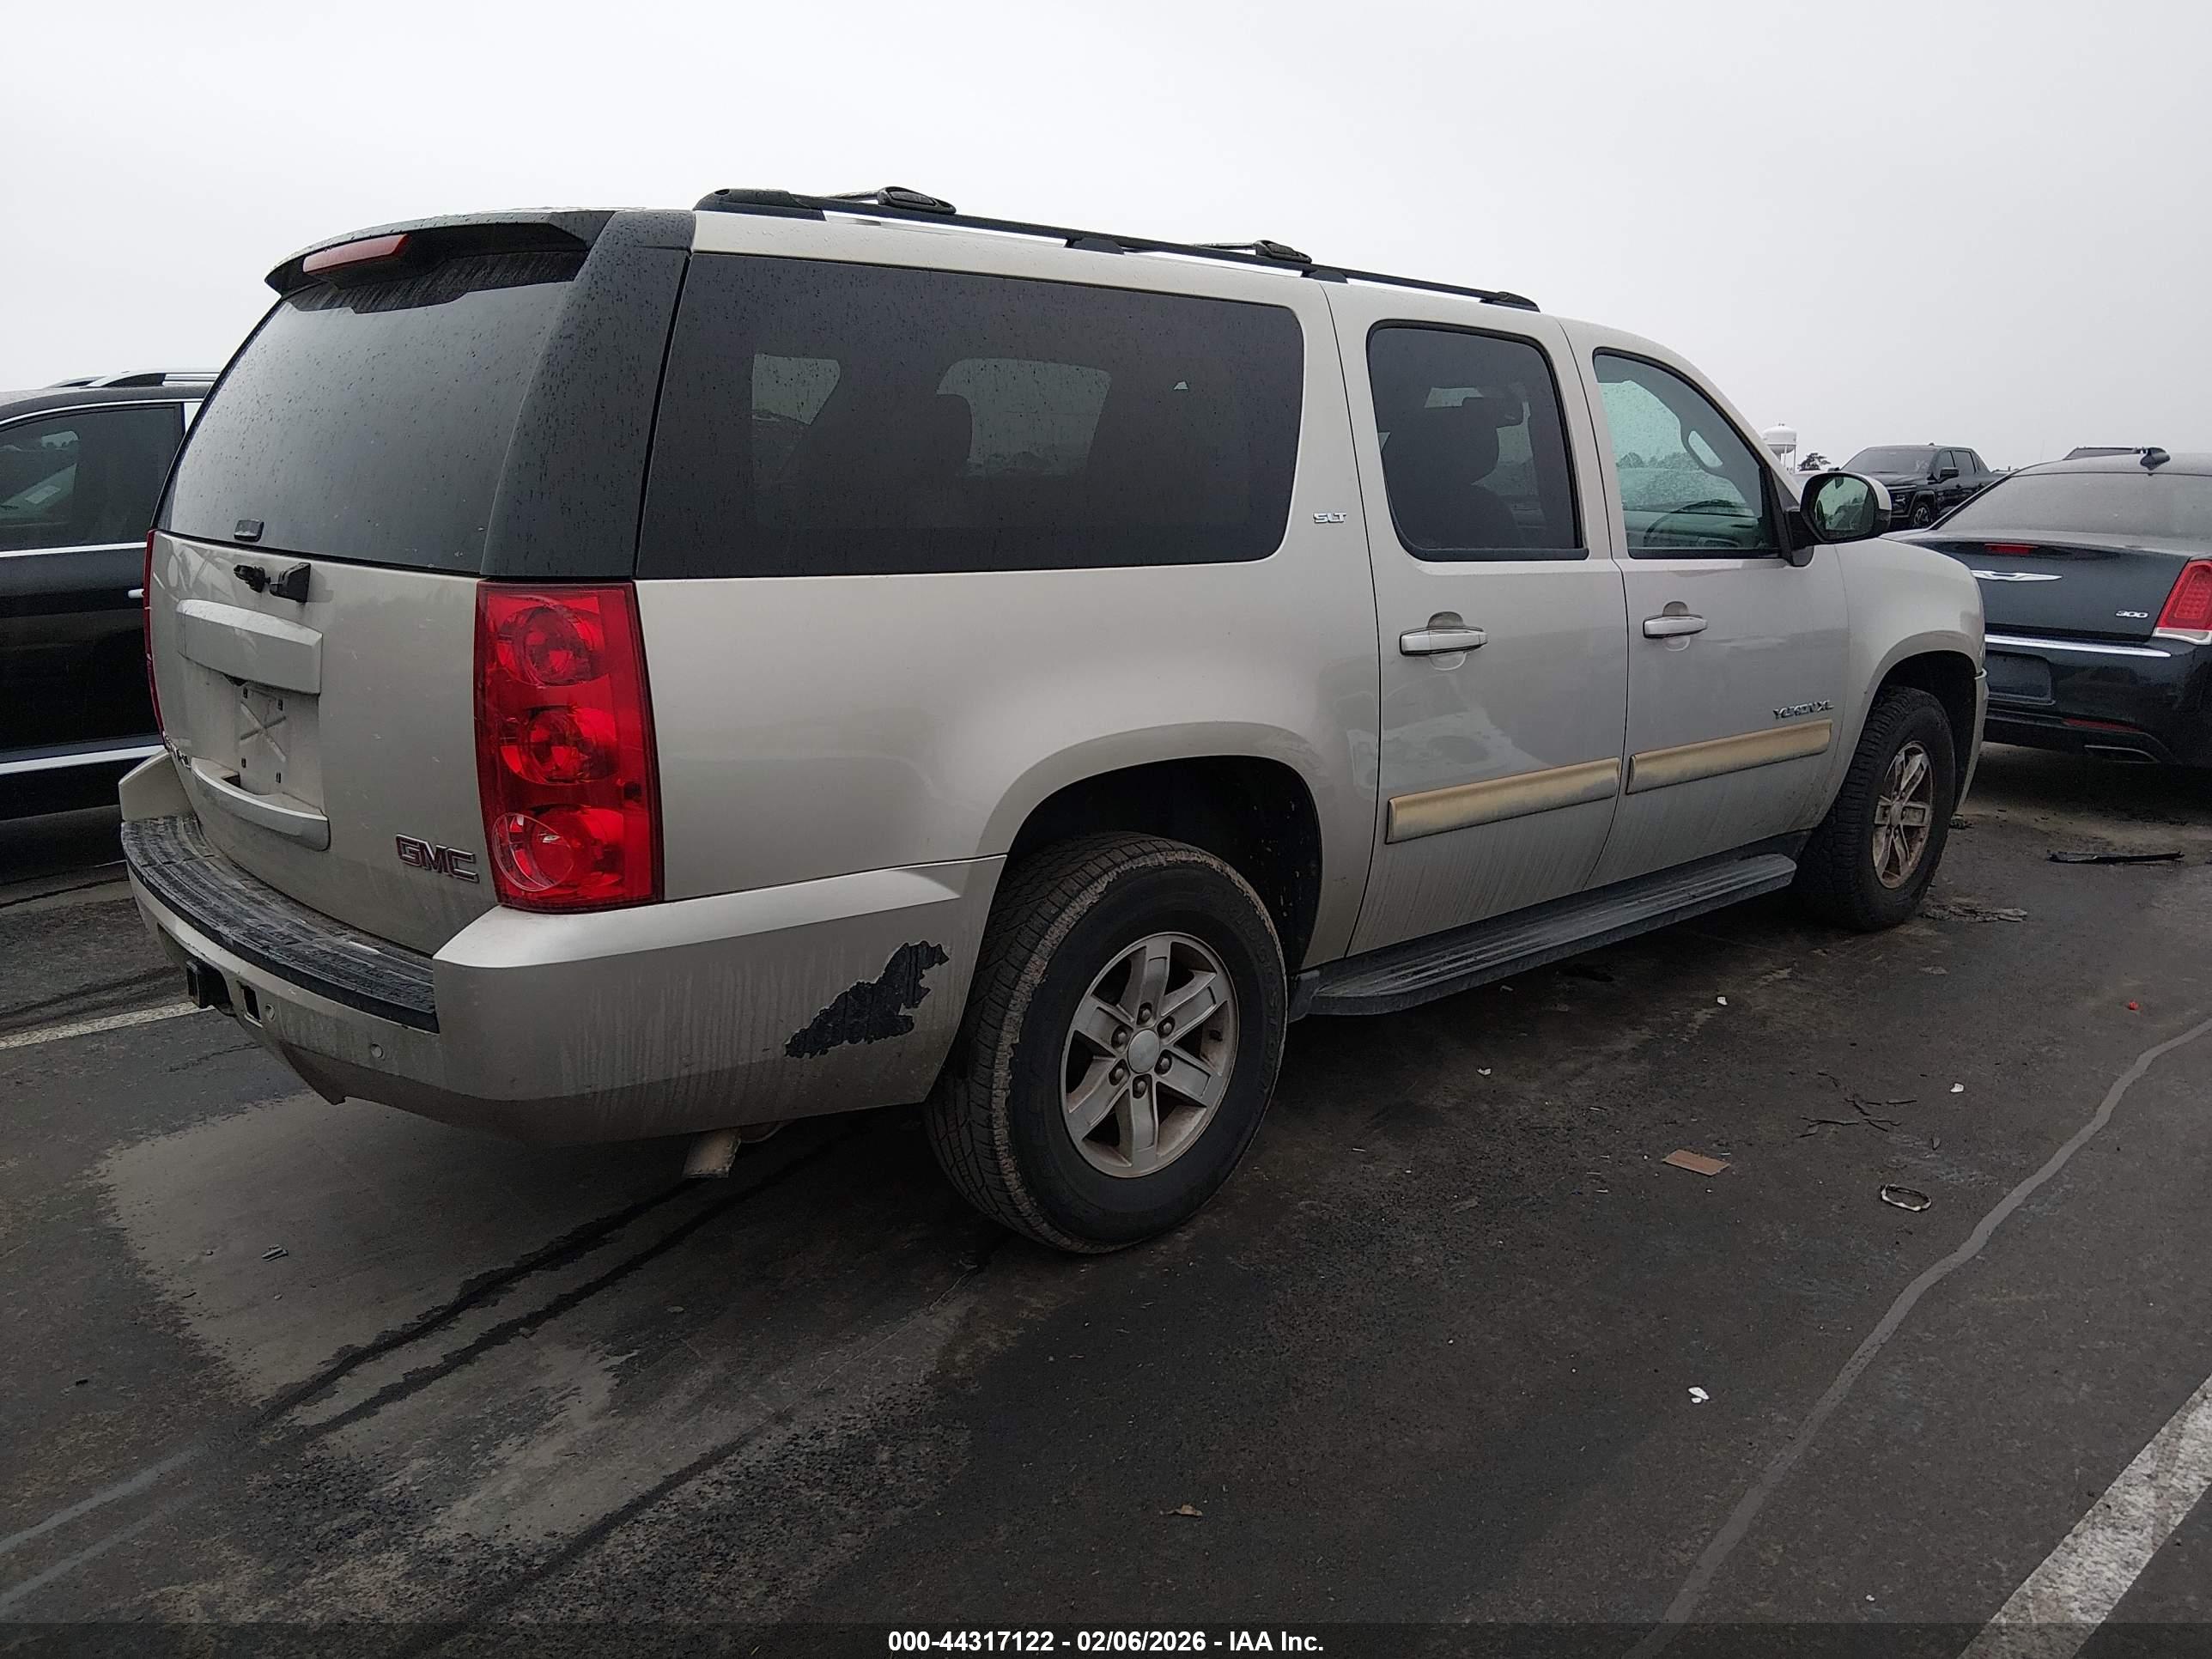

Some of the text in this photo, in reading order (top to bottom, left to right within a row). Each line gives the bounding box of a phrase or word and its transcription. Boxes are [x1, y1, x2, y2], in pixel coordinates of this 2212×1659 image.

[1313, 513, 1346, 524] SLT
[2115, 610, 2148, 618] 300
[395, 833, 480, 884] GMC
